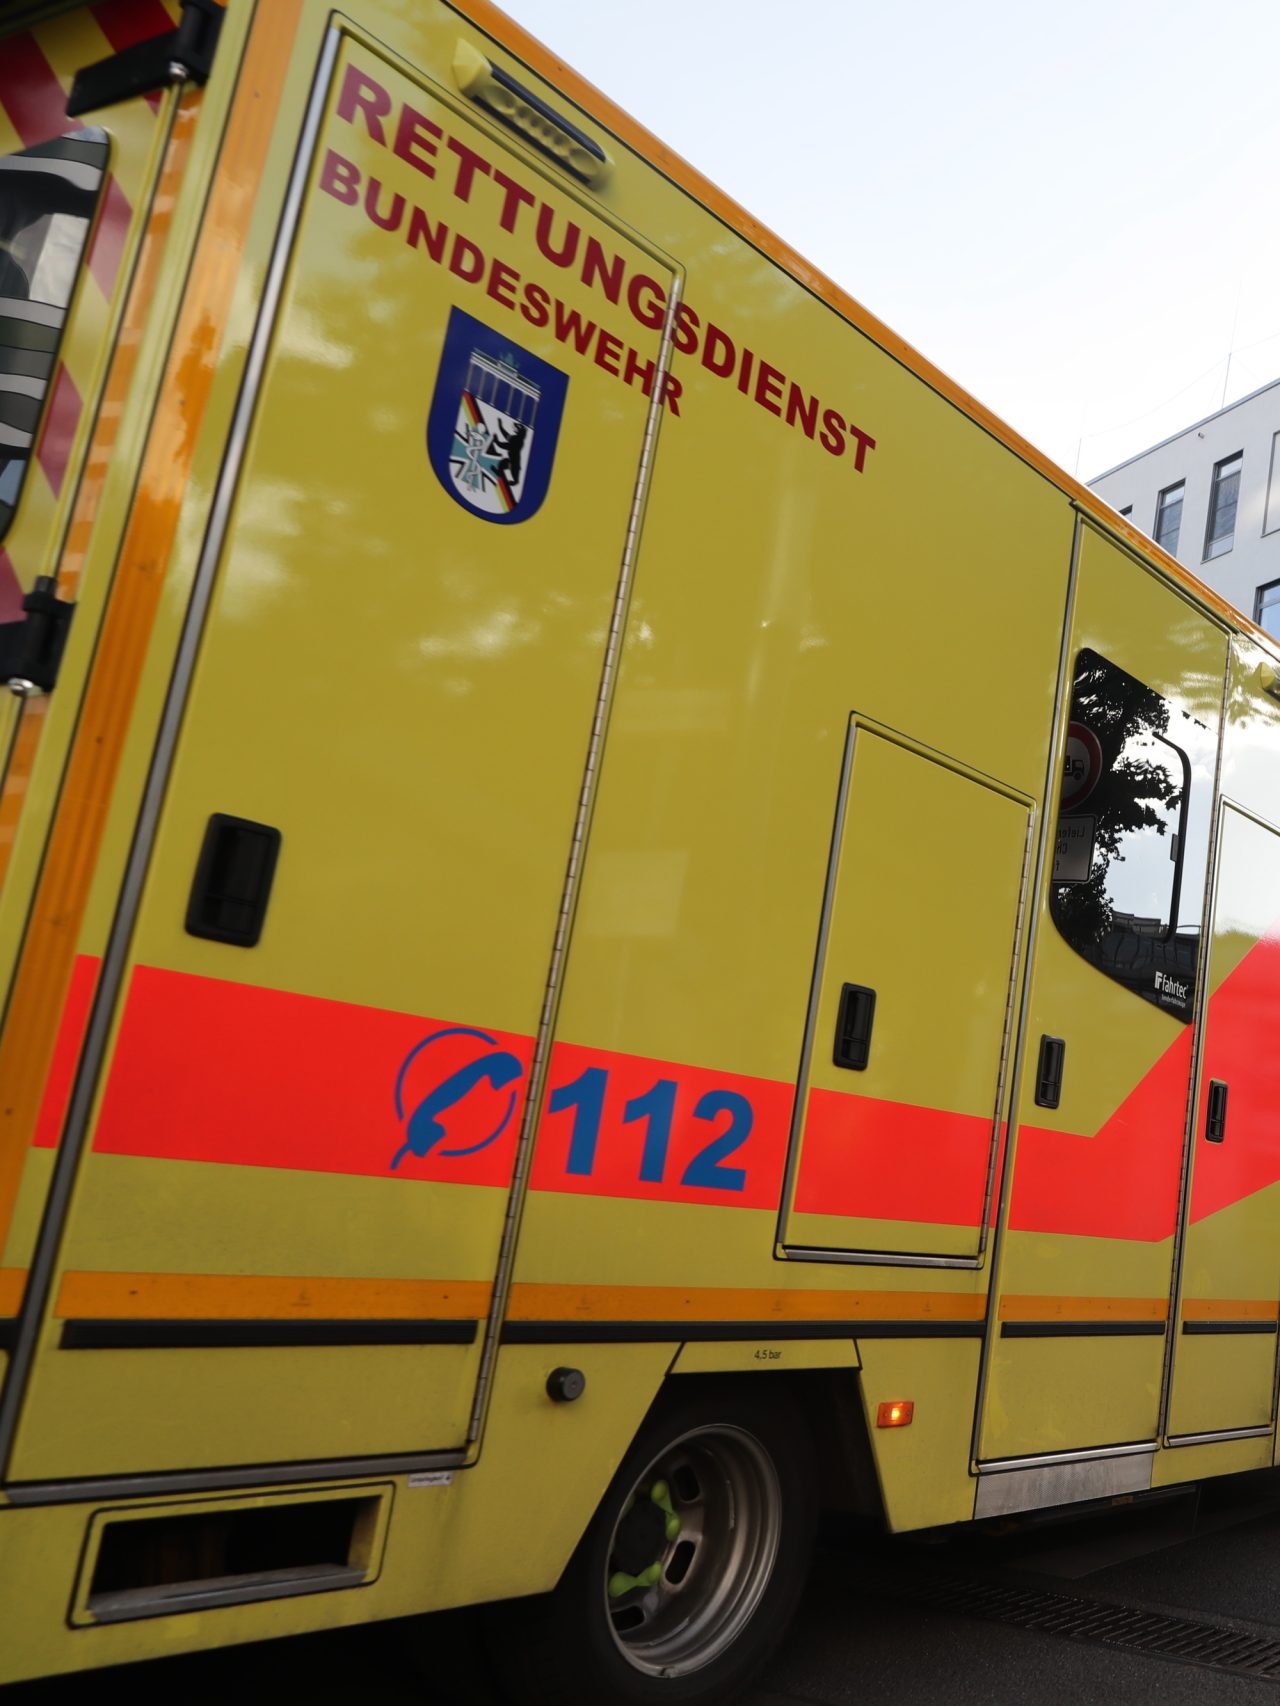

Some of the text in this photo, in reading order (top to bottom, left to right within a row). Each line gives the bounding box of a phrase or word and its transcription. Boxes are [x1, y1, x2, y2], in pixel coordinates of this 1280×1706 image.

[319, 149, 682, 417] BUNDESWEHR
[336, 62, 876, 472] RETTUNGSDIENST
[548, 1066, 754, 1192] 112
